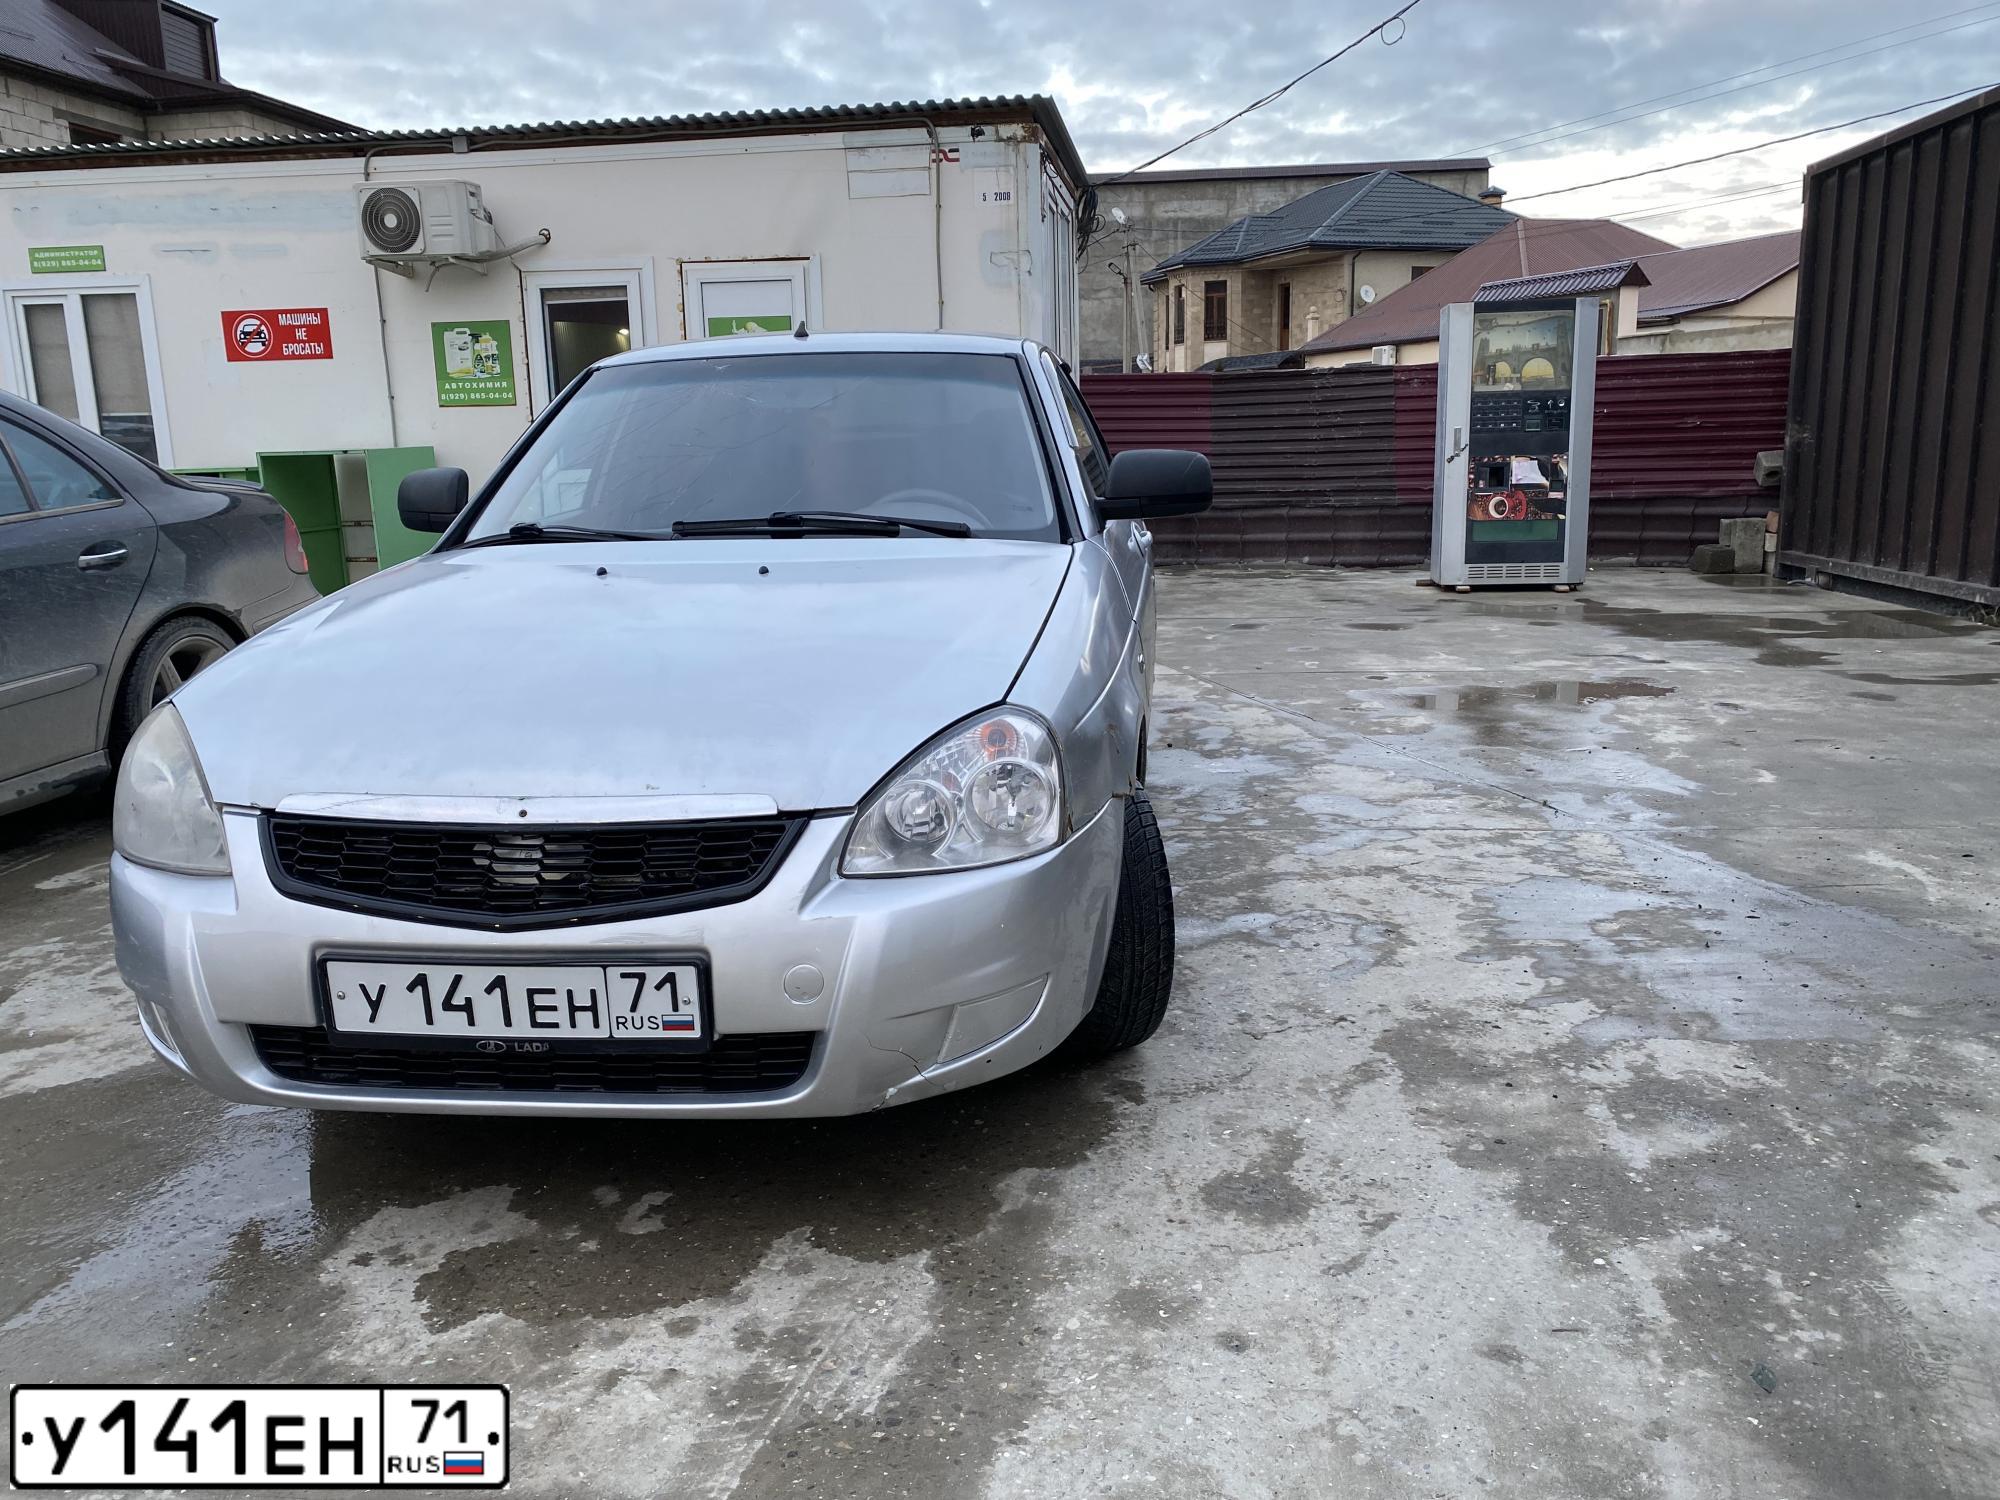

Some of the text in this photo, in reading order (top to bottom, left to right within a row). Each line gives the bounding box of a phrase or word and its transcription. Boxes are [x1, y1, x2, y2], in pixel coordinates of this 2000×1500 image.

[982, 192, 987, 202] 5
[34, 250, 98, 258] АДМИНИСТРАТОР
[278, 312, 321, 326] МАШИНЫ
[295, 328, 308, 340] НЕ
[282, 342, 324, 356] БРОСАТЬ!
[444, 381, 507, 389] АВТОХИМИЯ
[619, 971, 679, 1013] 71
[616, 1015, 660, 1031] RUS
